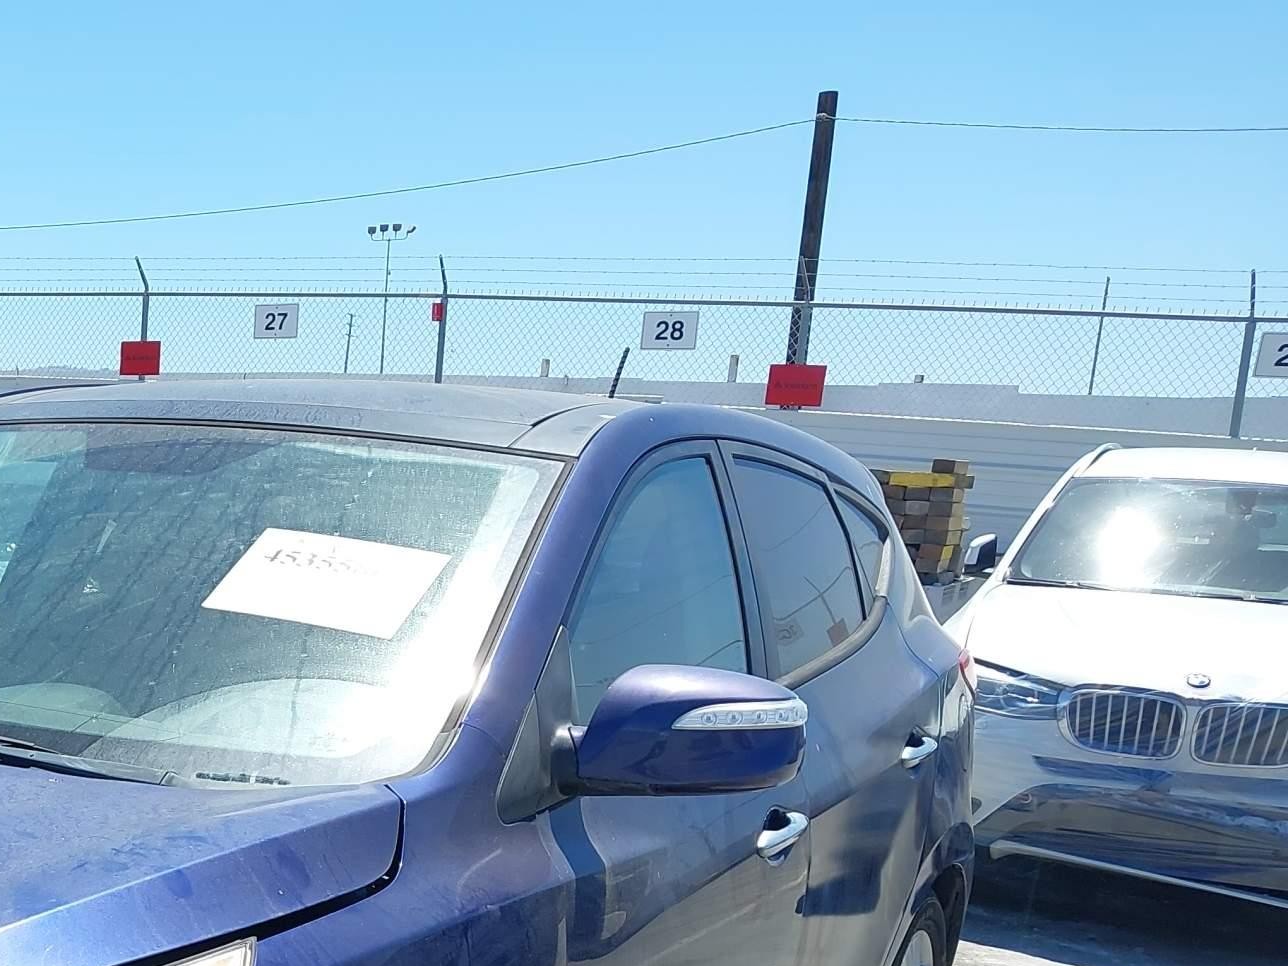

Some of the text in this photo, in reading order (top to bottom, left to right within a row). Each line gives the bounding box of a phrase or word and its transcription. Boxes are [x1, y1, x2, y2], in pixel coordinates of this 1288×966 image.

[264, 313, 288, 331] 27
[654, 320, 684, 341] 28
[1274, 343, 1288, 366] 2
